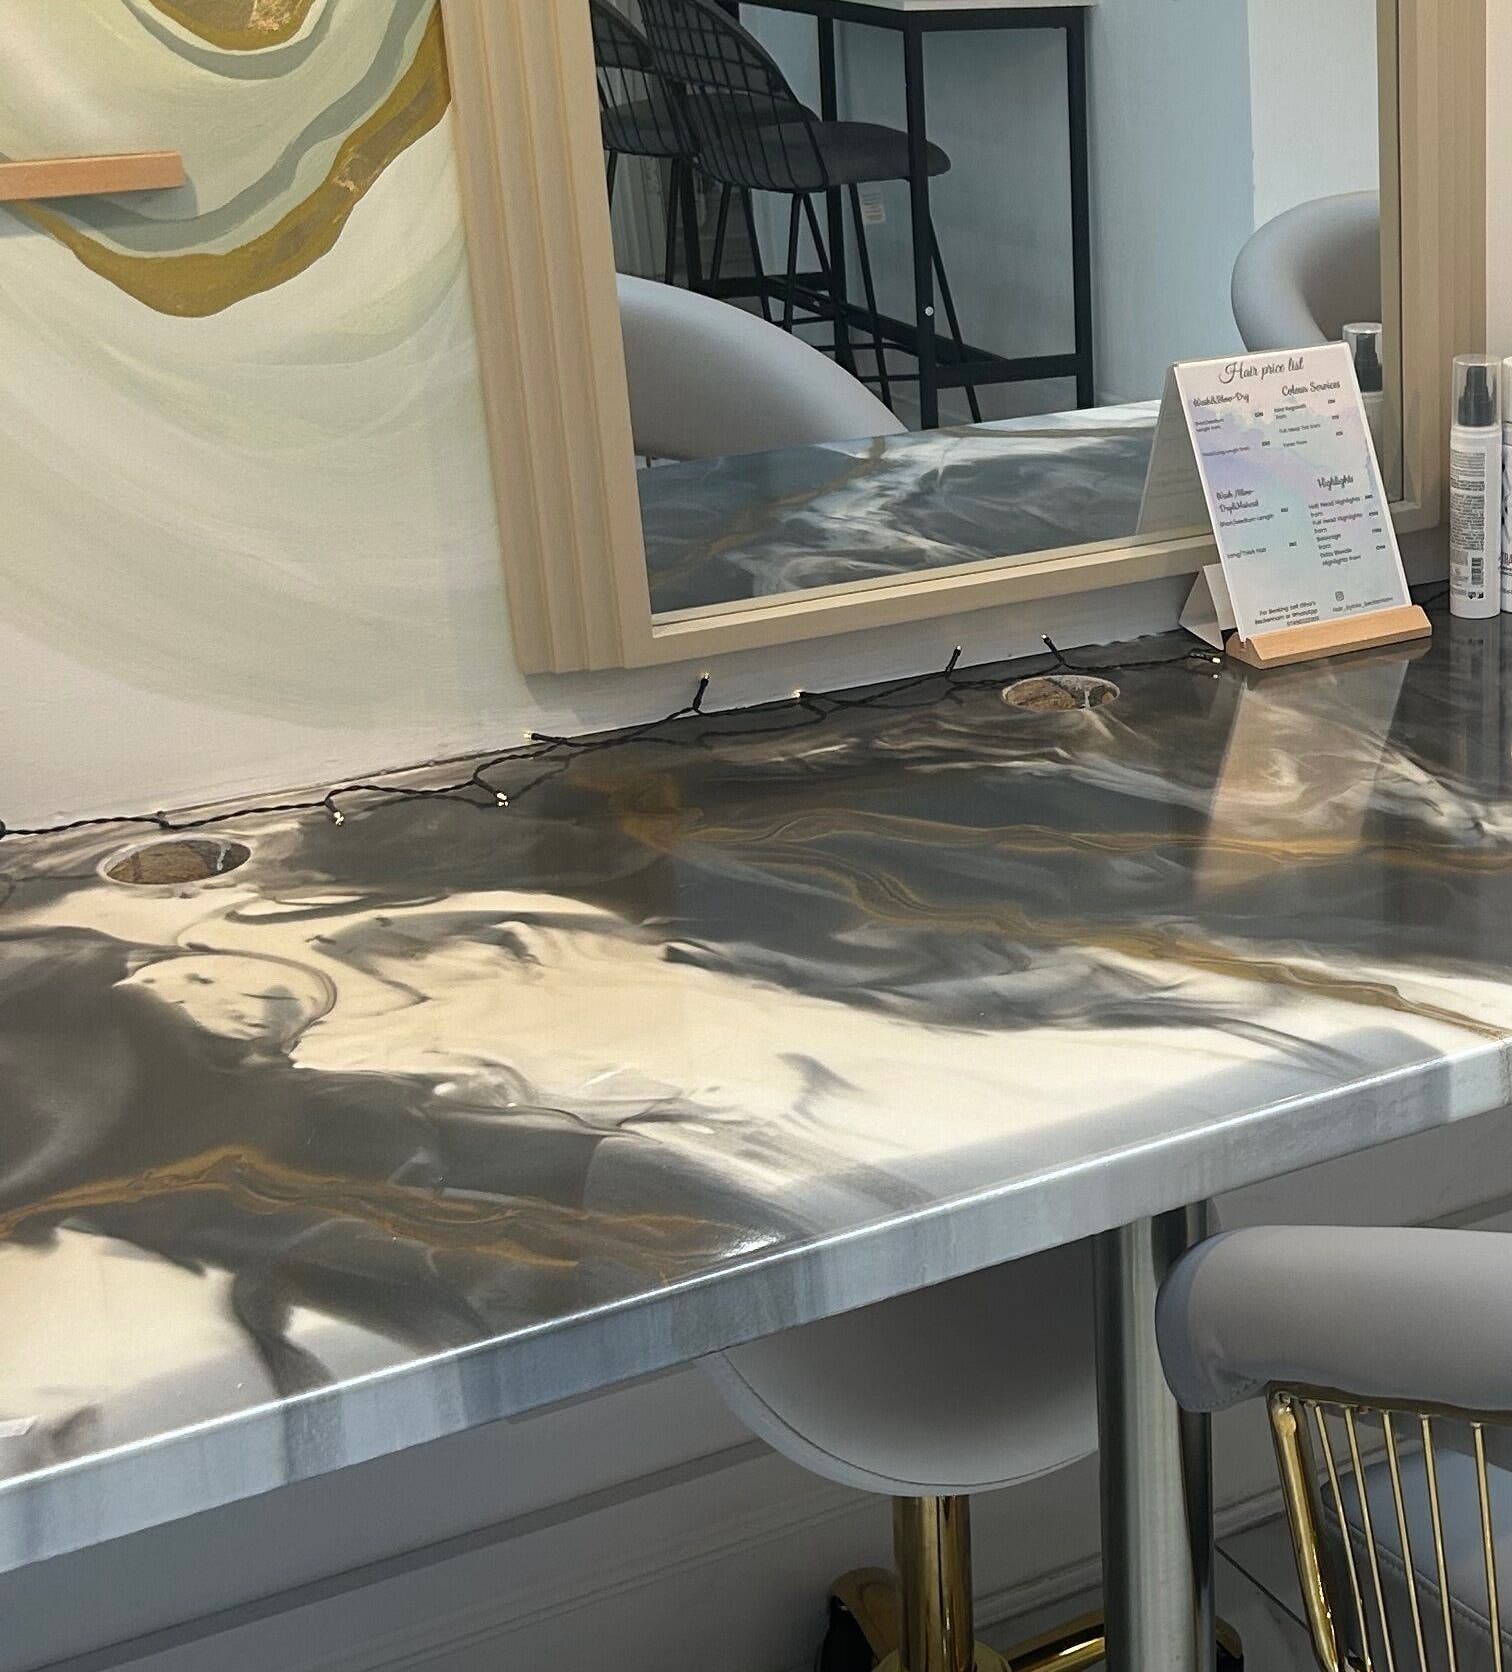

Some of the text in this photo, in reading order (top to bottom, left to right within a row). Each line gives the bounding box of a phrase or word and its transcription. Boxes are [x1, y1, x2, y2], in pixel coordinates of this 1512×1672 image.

[1217, 355, 1305, 385] Hair price list
